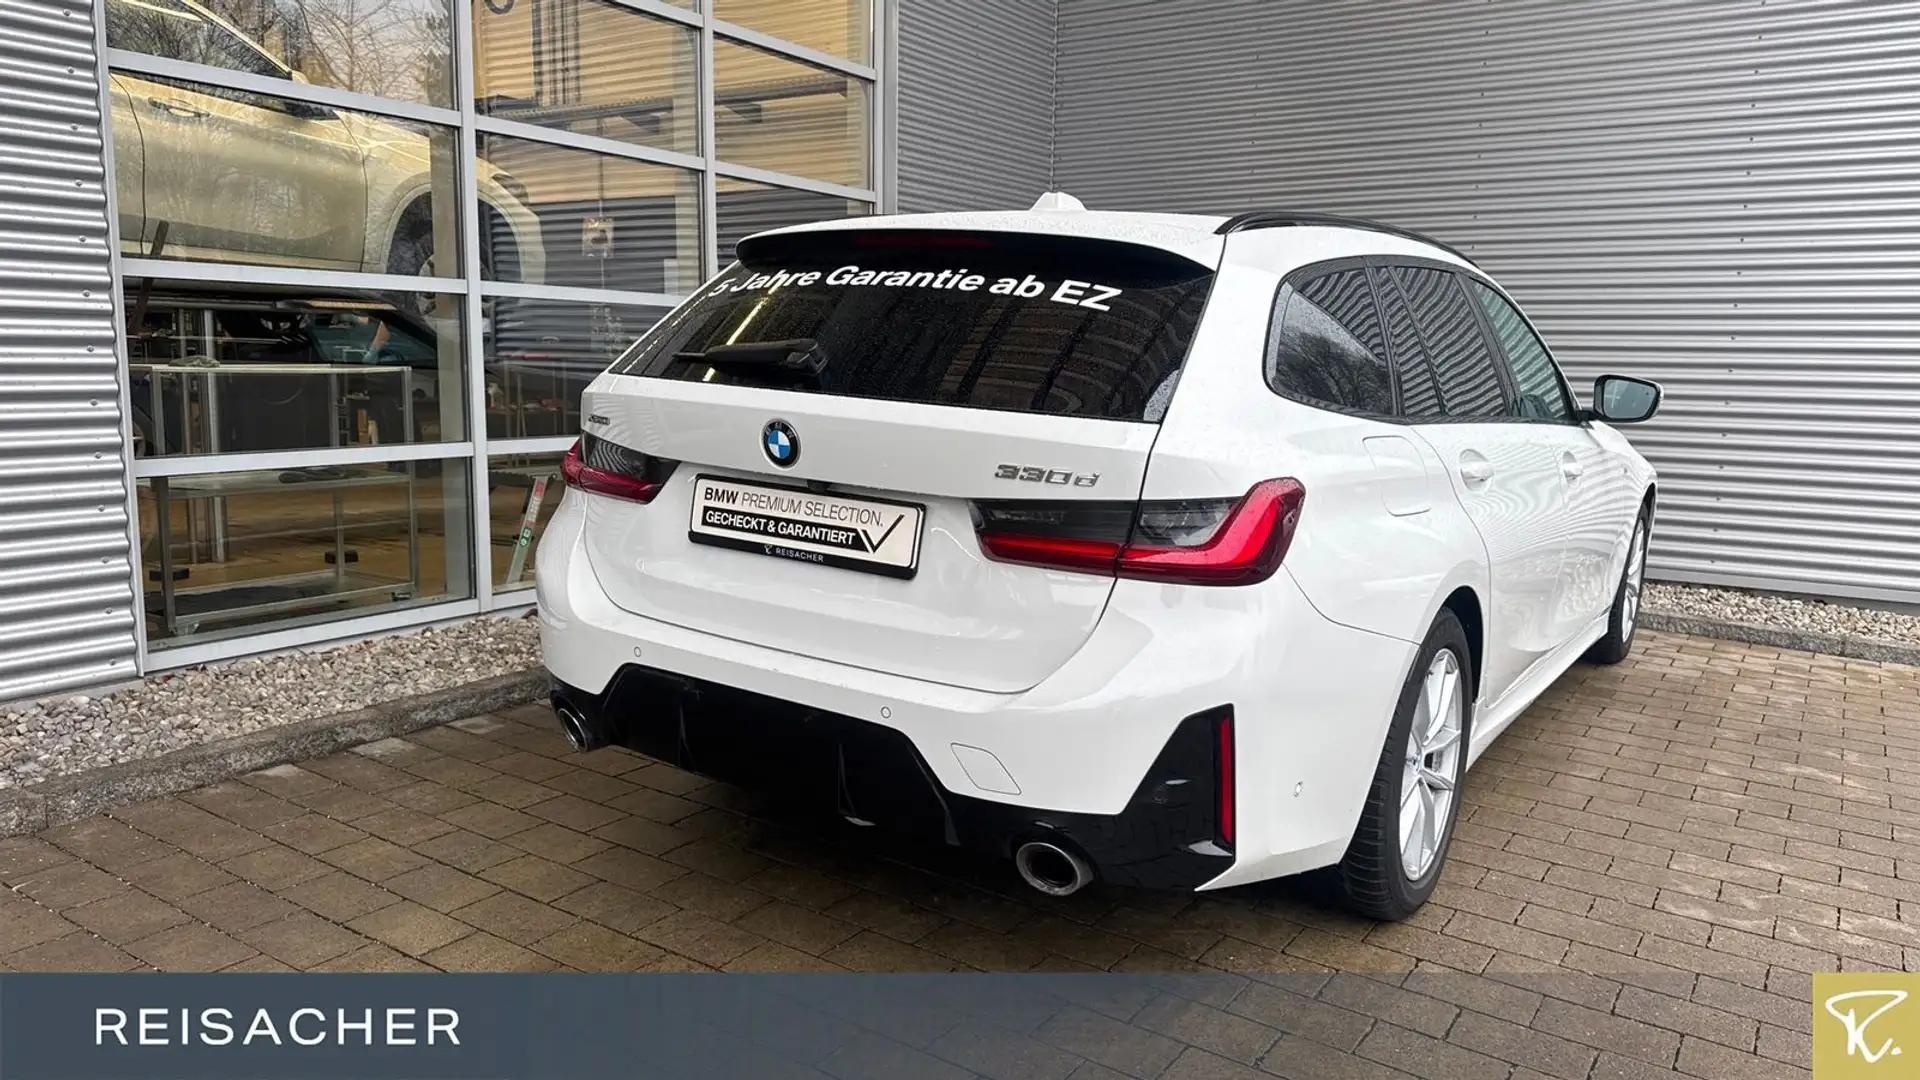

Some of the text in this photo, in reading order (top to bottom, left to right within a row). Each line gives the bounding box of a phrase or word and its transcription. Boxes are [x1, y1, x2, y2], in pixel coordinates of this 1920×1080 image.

[708, 265, 1122, 311] 5 Jahre Garantie ab EZ
[994, 463, 1101, 488] 330d
[704, 487, 884, 527] BMW PREMIUM SELECTION.
[705, 510, 856, 545] GECHECKT & GARANTIERT
[775, 547, 824, 563] REISACHER
